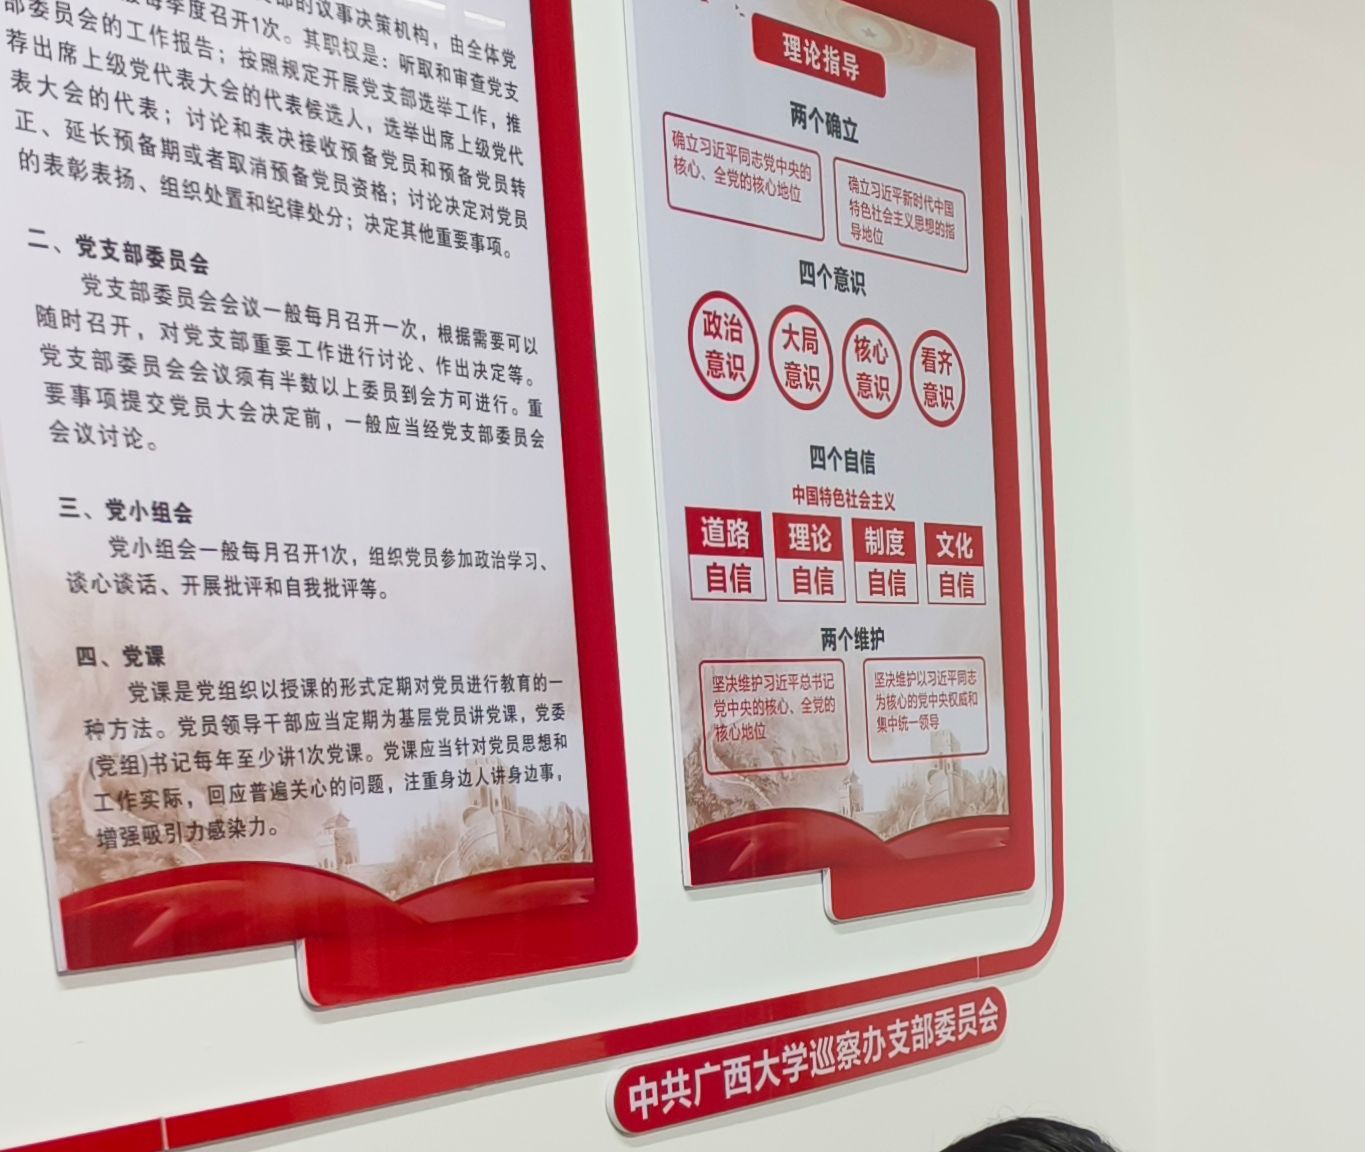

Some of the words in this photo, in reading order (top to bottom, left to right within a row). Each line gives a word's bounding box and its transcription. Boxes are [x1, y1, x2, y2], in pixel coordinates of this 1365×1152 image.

[265, 0, 517, 70] 的议事决策机构，由全体党
[121, 0, 520, 103] 每季度召开1次。其职权是：听取和审查党支
[782, 31, 860, 82] 理论指导
[789, 100, 859, 144] 两个确立
[672, 129, 812, 182] 确立习近平同志党中央的
[673, 156, 802, 203] 核心、全党的核心地位
[848, 175, 955, 218] 确立习近平新时代中国
[849, 199, 956, 241] 特色社会主义思想的指
[850, 222, 884, 247] 导地位
[28, 227, 209, 276] 二、党支部委员会
[799, 259, 867, 297] 四个意识
[702, 309, 744, 344] 政治
[781, 322, 819, 355] 大局
[705, 348, 747, 383] 意识
[853, 334, 889, 367] 核心
[921, 345, 954, 378] 看齐
[784, 360, 821, 394] 意识
[856, 371, 891, 403] 意识
[922, 381, 955, 412] 意识
[49, 420, 158, 452] 会议讨论。
[809, 444, 876, 475] 四个自信
[58, 495, 193, 525] 三、党小组会
[792, 484, 896, 512] 中国特色社会主义
[701, 516, 750, 550] 道路
[788, 522, 832, 553] 理论
[864, 526, 906, 557] 制度
[936, 531, 974, 560] 文化
[67, 570, 389, 600] 谈心谈话、开展批评和自我批评等。
[705, 562, 752, 594] 自信
[793, 565, 835, 597] 自信
[868, 568, 907, 598] 自信
[939, 571, 975, 599] 自信
[820, 626, 885, 652] 两个维护
[76, 644, 166, 669] 四、党课
[128, 672, 563, 705] 党课是党组织以授课的形式定期对党员进行教育的一
[712, 672, 835, 692] 坚决维护习近平总书记
[874, 669, 977, 689] 坚决维护以习近平同志
[713, 695, 836, 718] 党中央的核心、全党的
[875, 691, 978, 712] 为核心的党中央权威和
[715, 720, 767, 742] 核心地位
[876, 714, 940, 733] 集中统一领导
[96, 815, 279, 851] 增强吸引力感染力。
[629, 996, 999, 1121] 中共广西大学巡察办支部委员会
